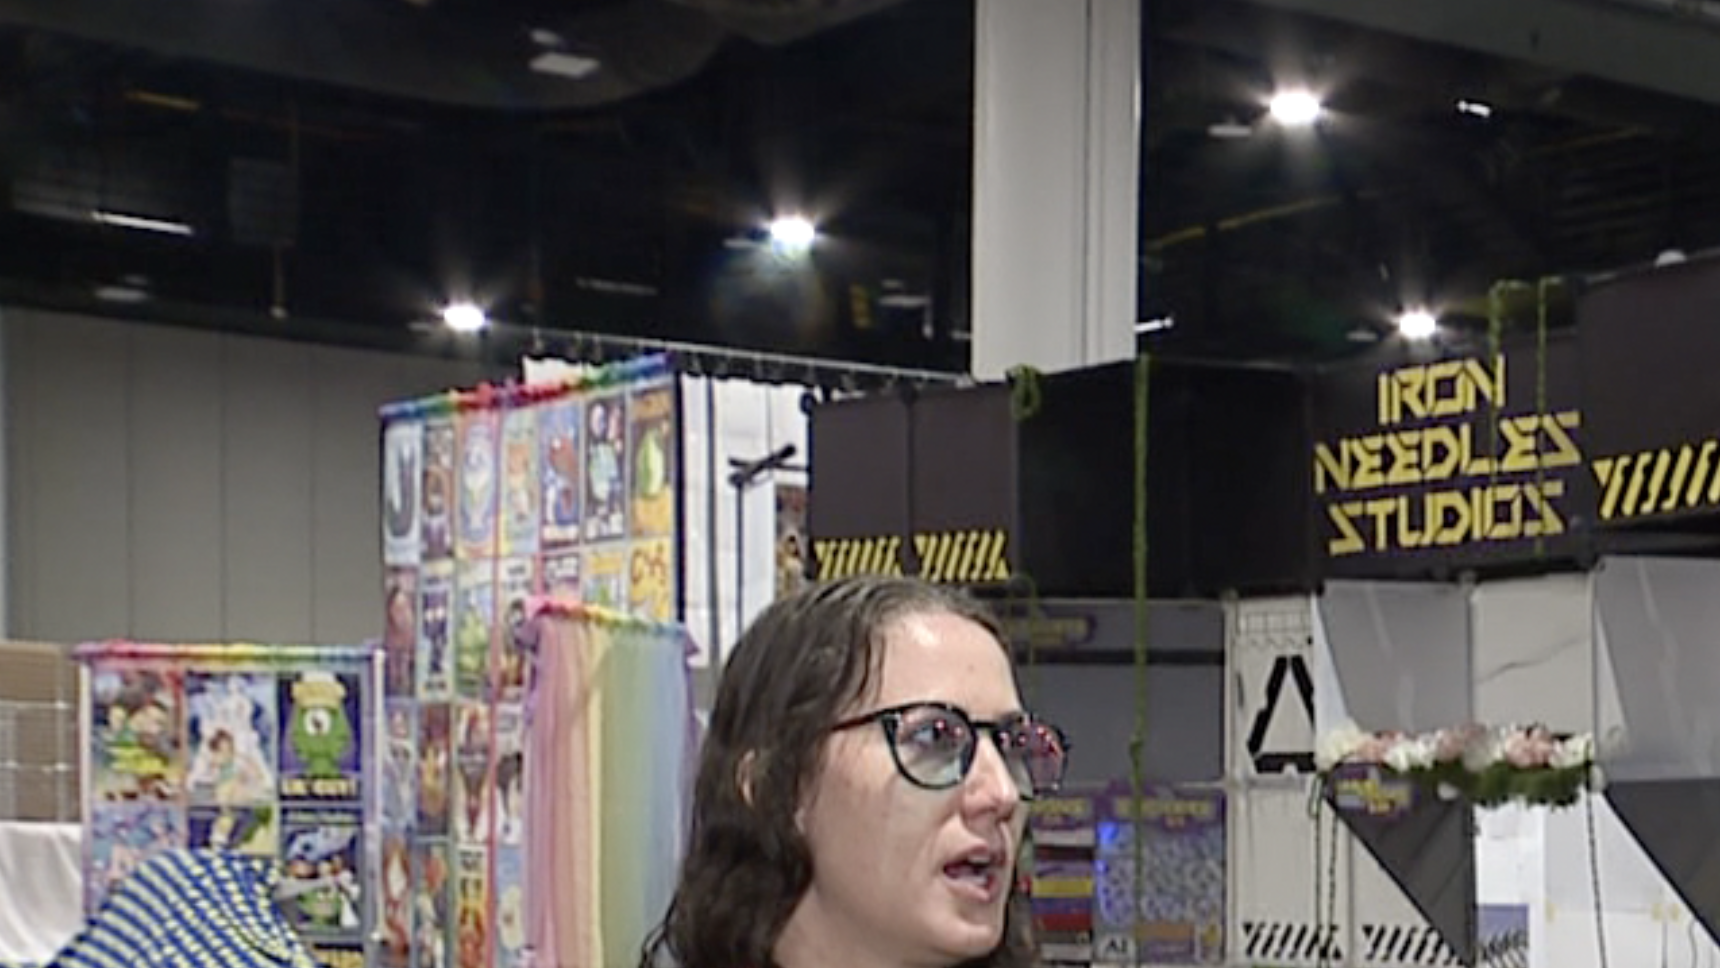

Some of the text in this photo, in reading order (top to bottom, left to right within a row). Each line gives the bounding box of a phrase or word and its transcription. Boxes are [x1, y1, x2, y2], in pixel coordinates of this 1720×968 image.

[1377, 353, 1506, 426] IRON
[1314, 411, 1582, 494] NEEDLES
[1328, 480, 1565, 556] STUDIOS
